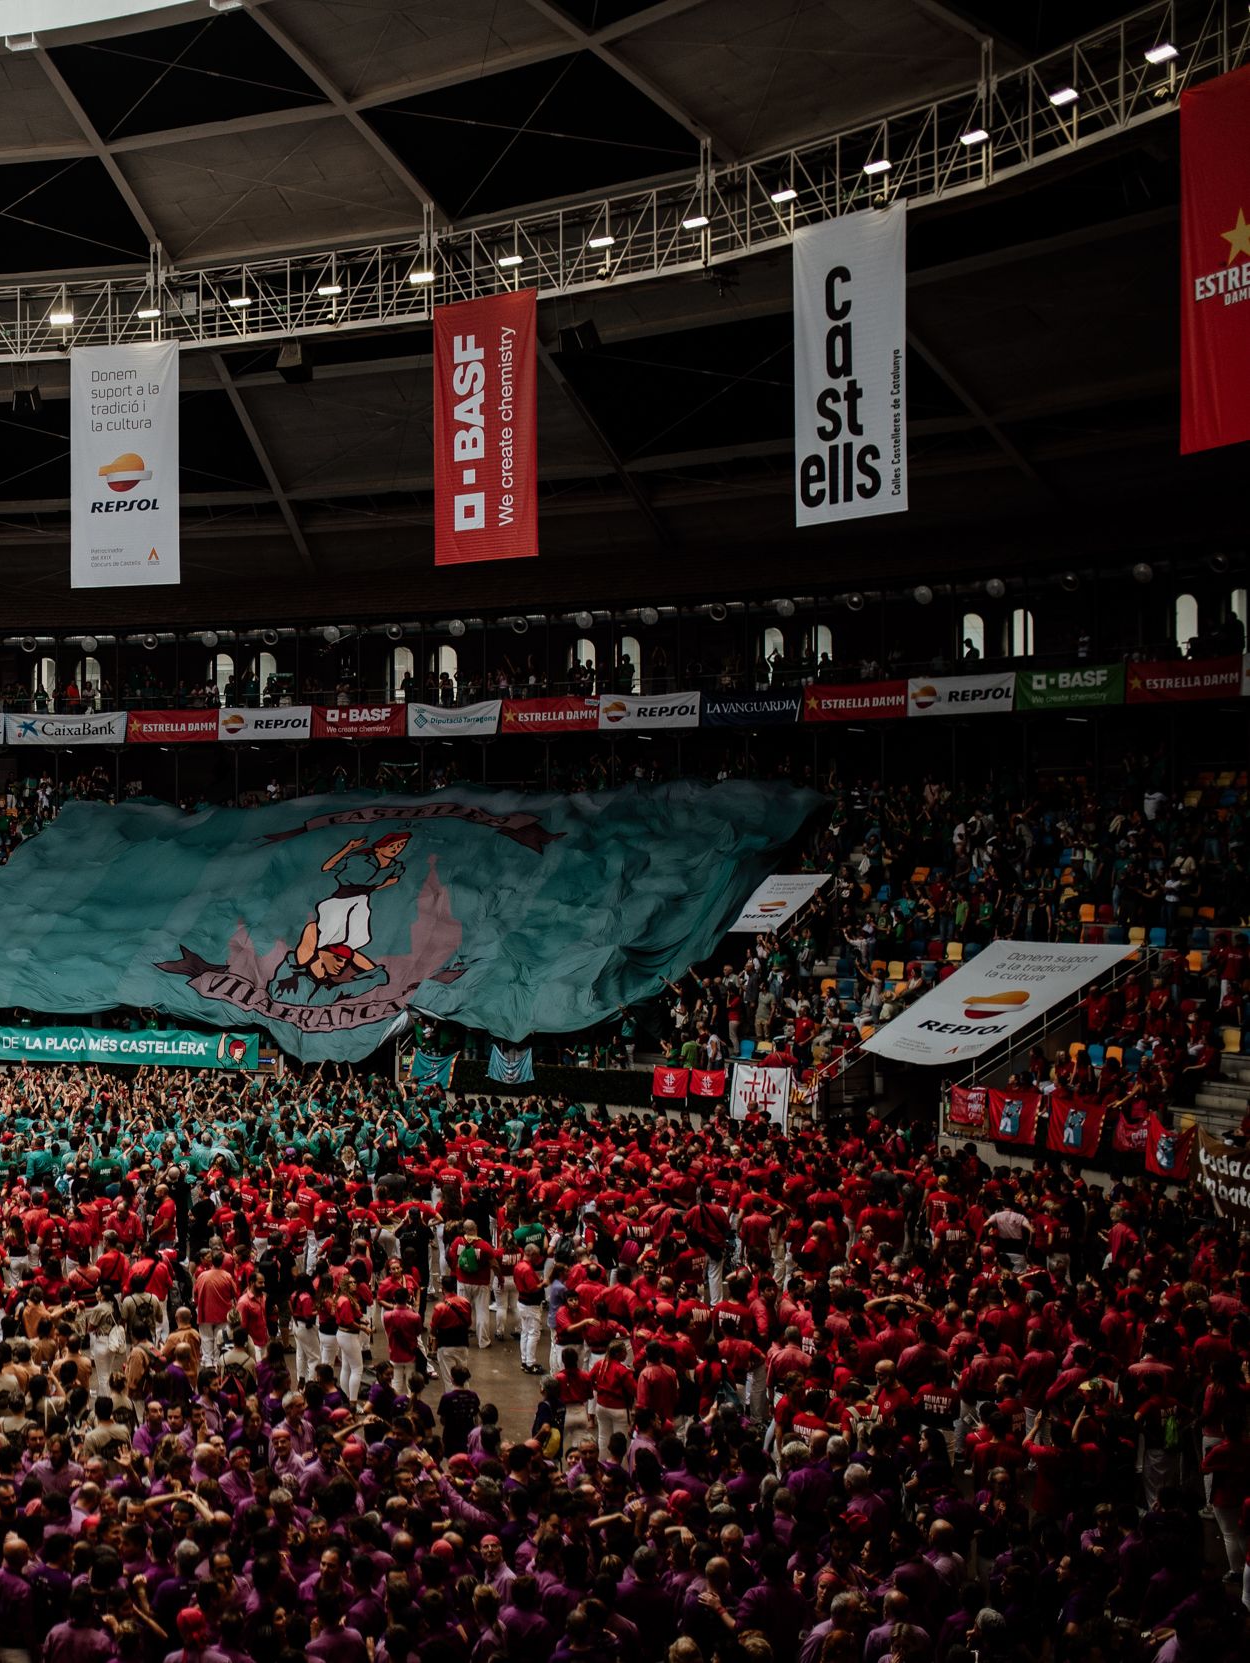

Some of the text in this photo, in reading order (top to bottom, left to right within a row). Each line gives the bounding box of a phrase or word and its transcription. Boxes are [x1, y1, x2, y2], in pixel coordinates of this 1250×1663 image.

[91, 370, 137, 382] Donem
[91, 382, 160, 401] suport a la
[453, 334, 486, 463] BASF
[91, 400, 146, 416] tradició i
[91, 418, 152, 433] la cultura
[498, 327, 516, 527] We create chemistry
[891, 349, 901, 496] Colles Castelleres de Catalunya
[90, 498, 160, 513] REPSOL
[1058, 670, 1108, 688] BASF
[1146, 673, 1239, 690] ESTRELLA DAMM
[949, 687, 1012, 702] REPSOL
[707, 699, 797, 714] LA VANGUARDIA
[821, 696, 905, 709] ESTRELLA DAMM
[349, 708, 391, 722] BASF
[518, 709, 597, 722] ESTRELLA DAMM
[637, 706, 697, 717] REPSOL
[142, 722, 216, 732] ESTRELLA DAMM
[254, 718, 309, 729] REPSOL
[430, 715, 496, 725] Diputació Tarragona
[41, 721, 115, 736] CaixaBank
[359, 725, 391, 733] chemistry
[1007, 952, 1099, 963] Donem suport
[1023, 964, 1071, 972] tradició
[999, 972, 1046, 981] cultura
[917, 1020, 1009, 1035] REPSOL
[2, 1037, 19, 1049] DE
[46, 1037, 87, 1053] PLAÇA
[89, 1035, 118, 1051] MÉS
